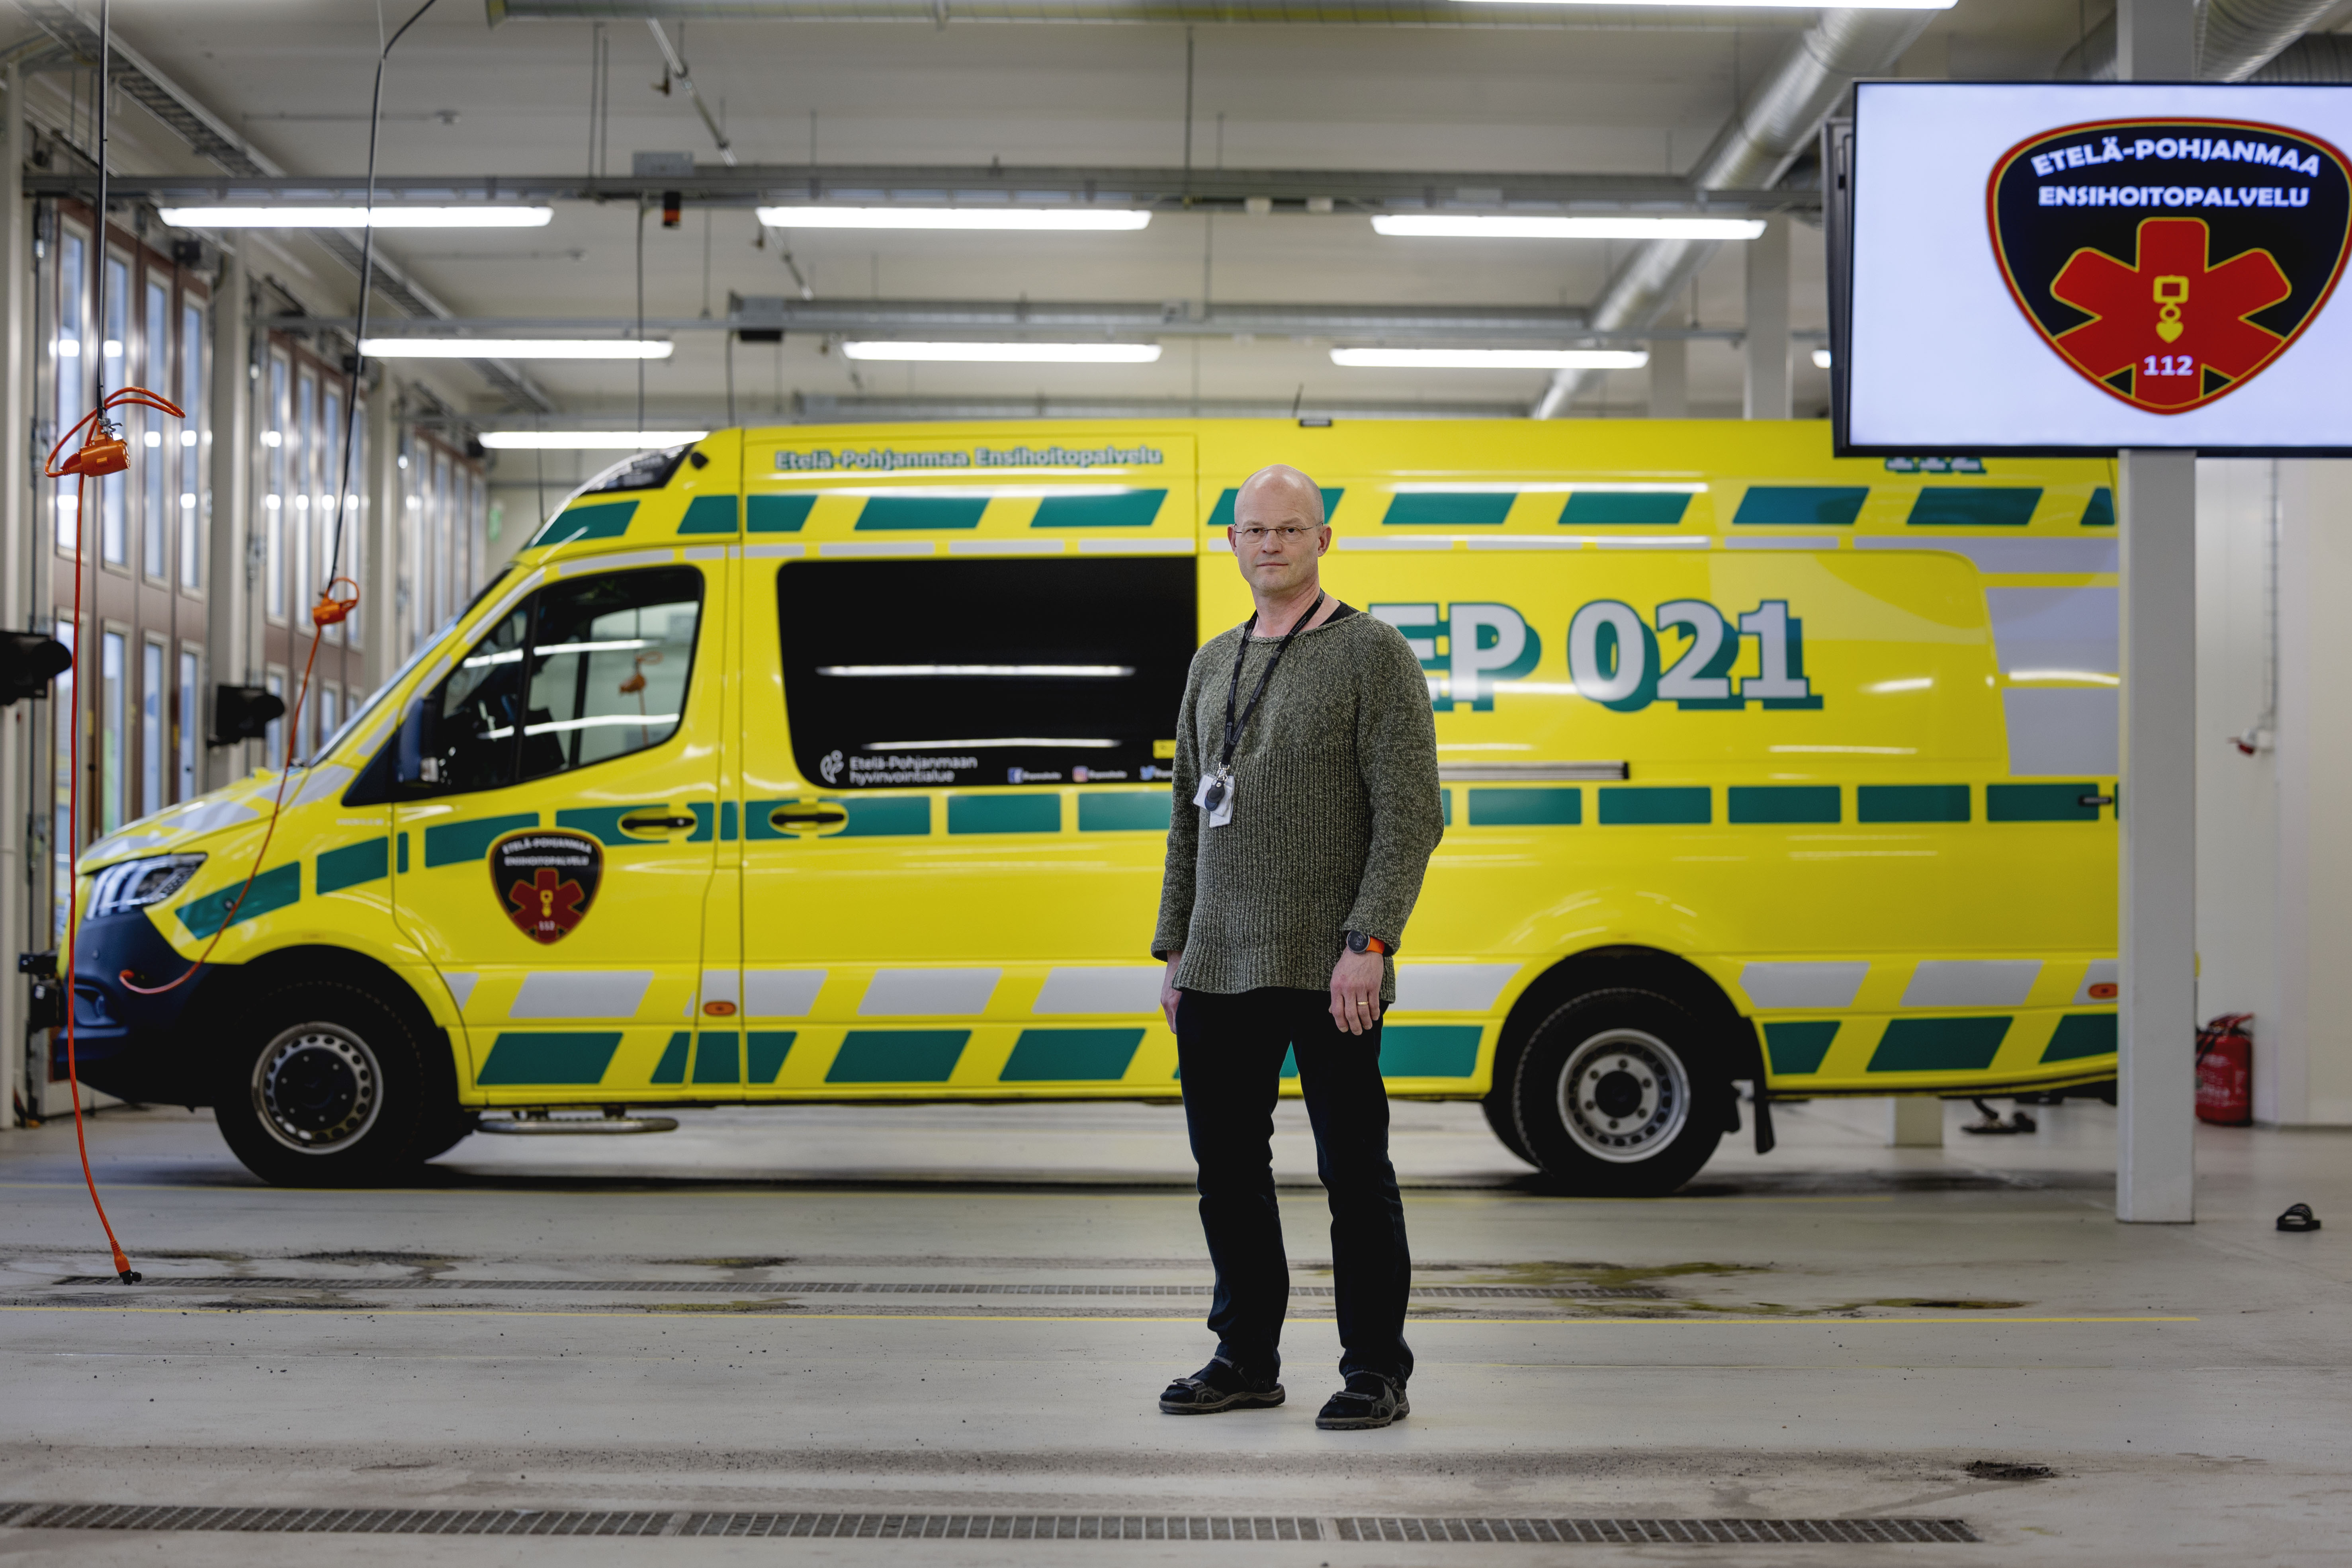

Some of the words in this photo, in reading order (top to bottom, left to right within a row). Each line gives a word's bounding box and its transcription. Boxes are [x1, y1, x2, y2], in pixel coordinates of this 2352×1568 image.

[2031, 136, 2321, 177] ETELÄ-POHJANMAA
[2038, 186, 2309, 207] ENSIHOITOPALVELU
[2143, 355, 2193, 376] 112
[774, 448, 970, 471] Etelä-Pohjanmaa
[974, 445, 1163, 467] Ensihoitopalvelu
[1567, 598, 1822, 711] 021
